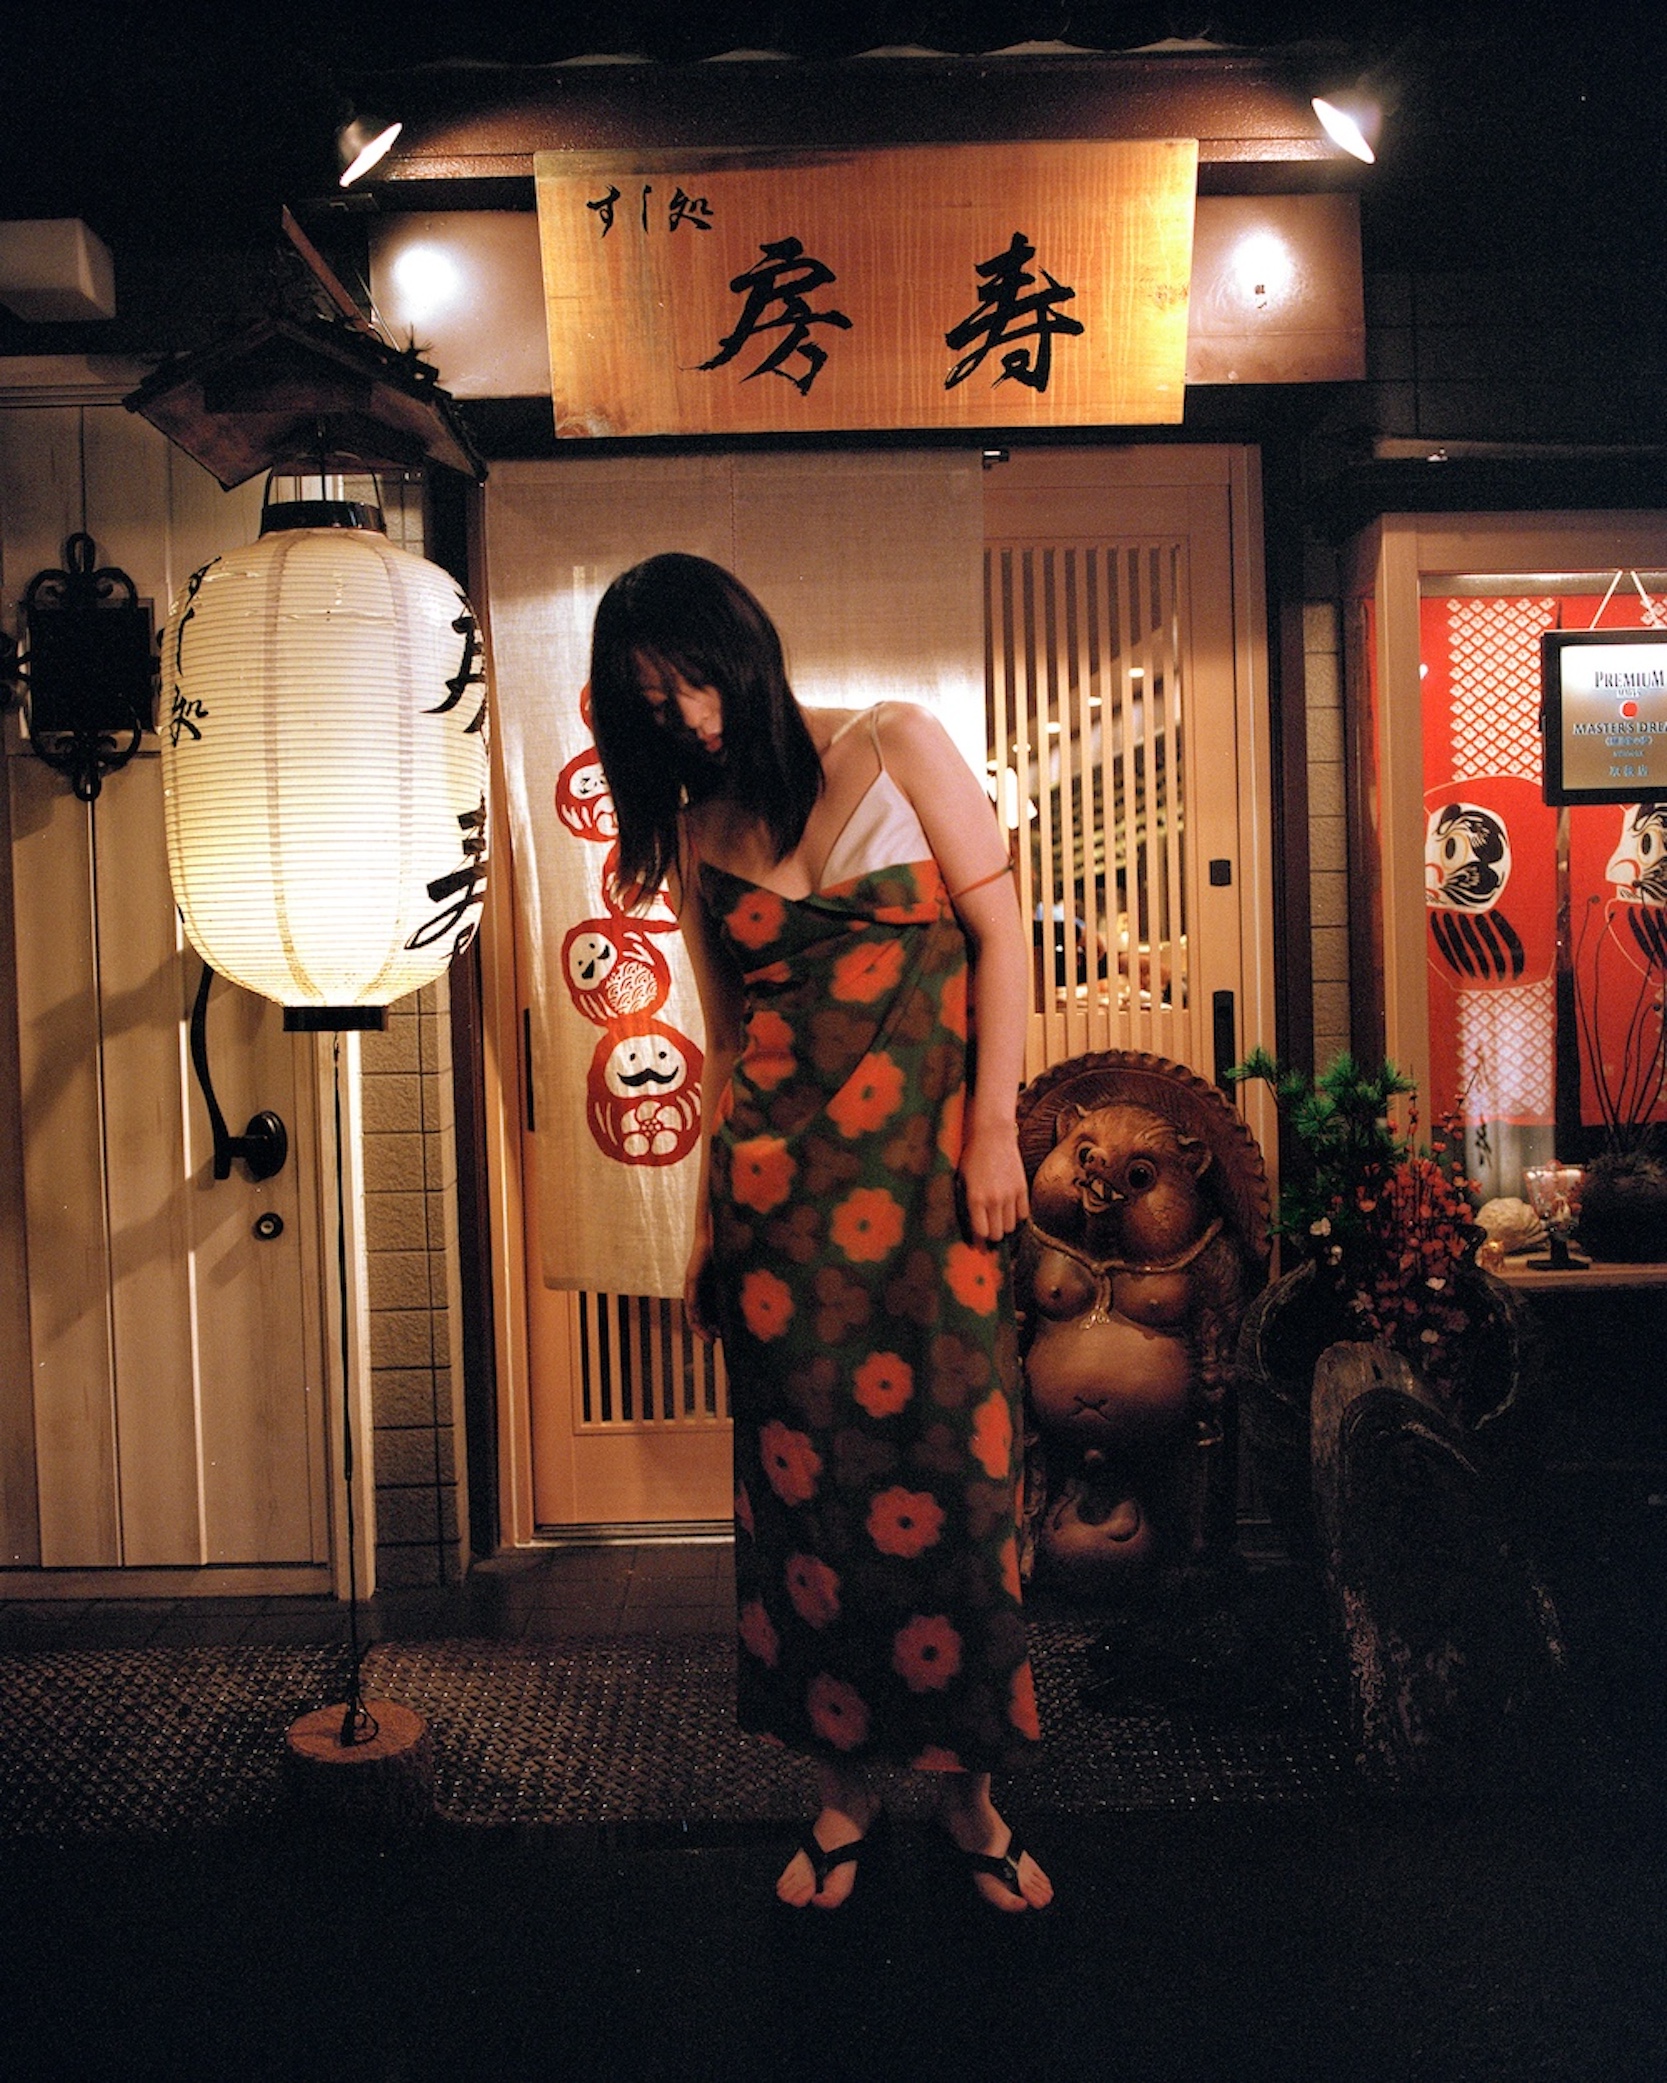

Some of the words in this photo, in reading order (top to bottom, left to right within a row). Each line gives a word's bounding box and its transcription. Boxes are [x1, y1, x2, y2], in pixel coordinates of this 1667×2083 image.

[586, 184, 714, 237] すし処
[1595, 670, 1664, 688] PREMIUM
